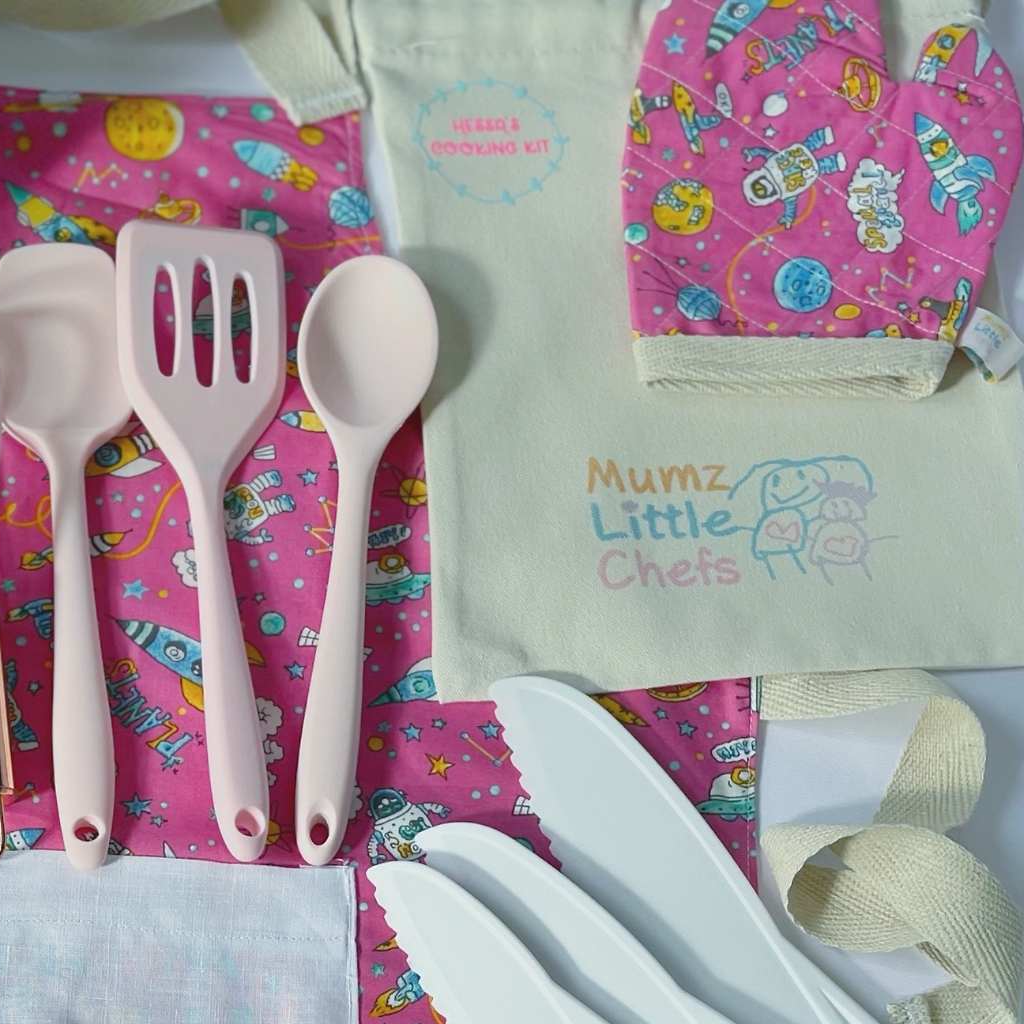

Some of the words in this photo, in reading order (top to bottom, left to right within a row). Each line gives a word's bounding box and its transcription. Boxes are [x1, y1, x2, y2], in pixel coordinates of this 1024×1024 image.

[431, 139, 517, 157] COOKING
[523, 138, 550, 155] KIT
[587, 456, 731, 493] Mumz
[591, 500, 739, 541] Little
[597, 547, 742, 590] Chefs
